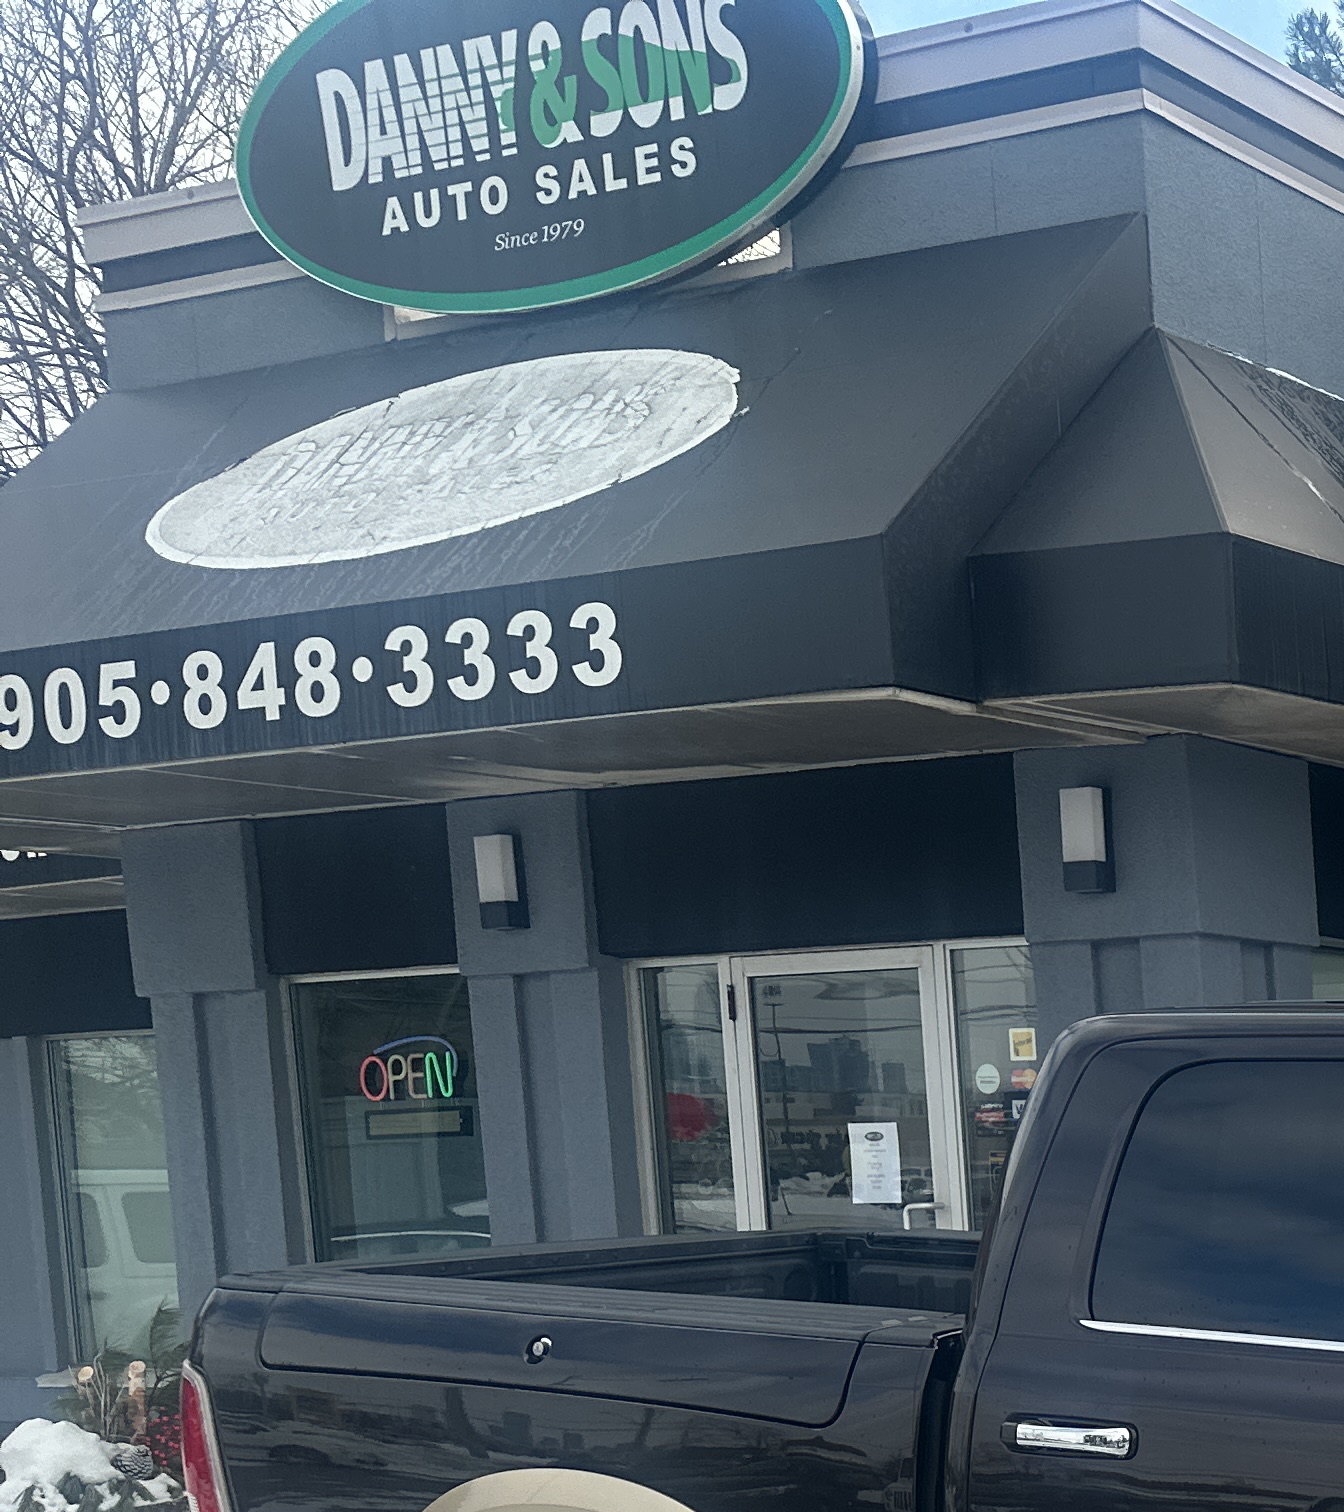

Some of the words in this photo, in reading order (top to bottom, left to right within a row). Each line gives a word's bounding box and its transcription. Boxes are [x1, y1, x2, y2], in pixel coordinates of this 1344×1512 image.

[314, 27, 518, 192] DANNY
[527, 19, 584, 150] &
[580, 0, 748, 138] SONS
[381, 175, 509, 236] AUTO
[534, 135, 698, 206] SALES
[494, 230, 539, 251] Since
[541, 218, 585, 242] 1979
[359, 1051, 454, 1102] OPEN
